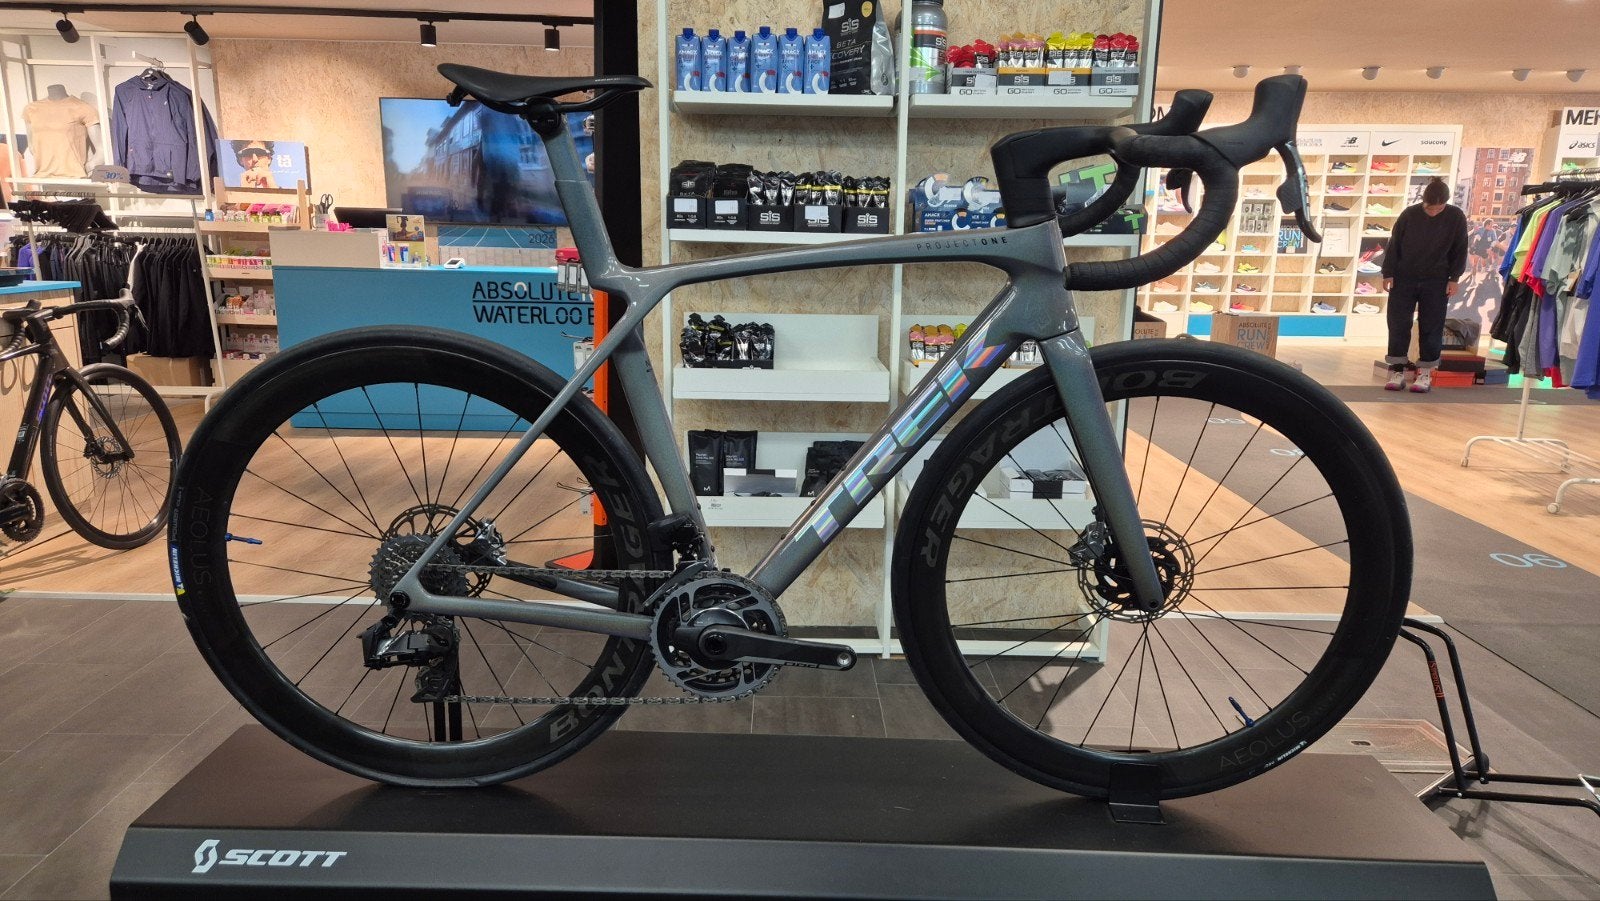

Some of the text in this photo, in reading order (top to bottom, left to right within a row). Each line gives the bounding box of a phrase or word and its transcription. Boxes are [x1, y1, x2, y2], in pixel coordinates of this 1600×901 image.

[836, 39, 856, 49] BETA
[832, 45, 865, 60] COVERY
[760, 211, 780, 221] SiS
[857, 213, 878, 224] SiS
[529, 234, 555, 244] 2026
[1278, 229, 1300, 241] RUN
[473, 305, 582, 325] WATERLOO
[1237, 329, 1266, 341] RUN
[1237, 341, 1265, 350] CREW
[794, 321, 1007, 543] TREK
[172, 547, 182, 582] MICHELIN
[1220, 711, 1310, 769] AEOLUS
[218, 849, 348, 867] SCOTT
